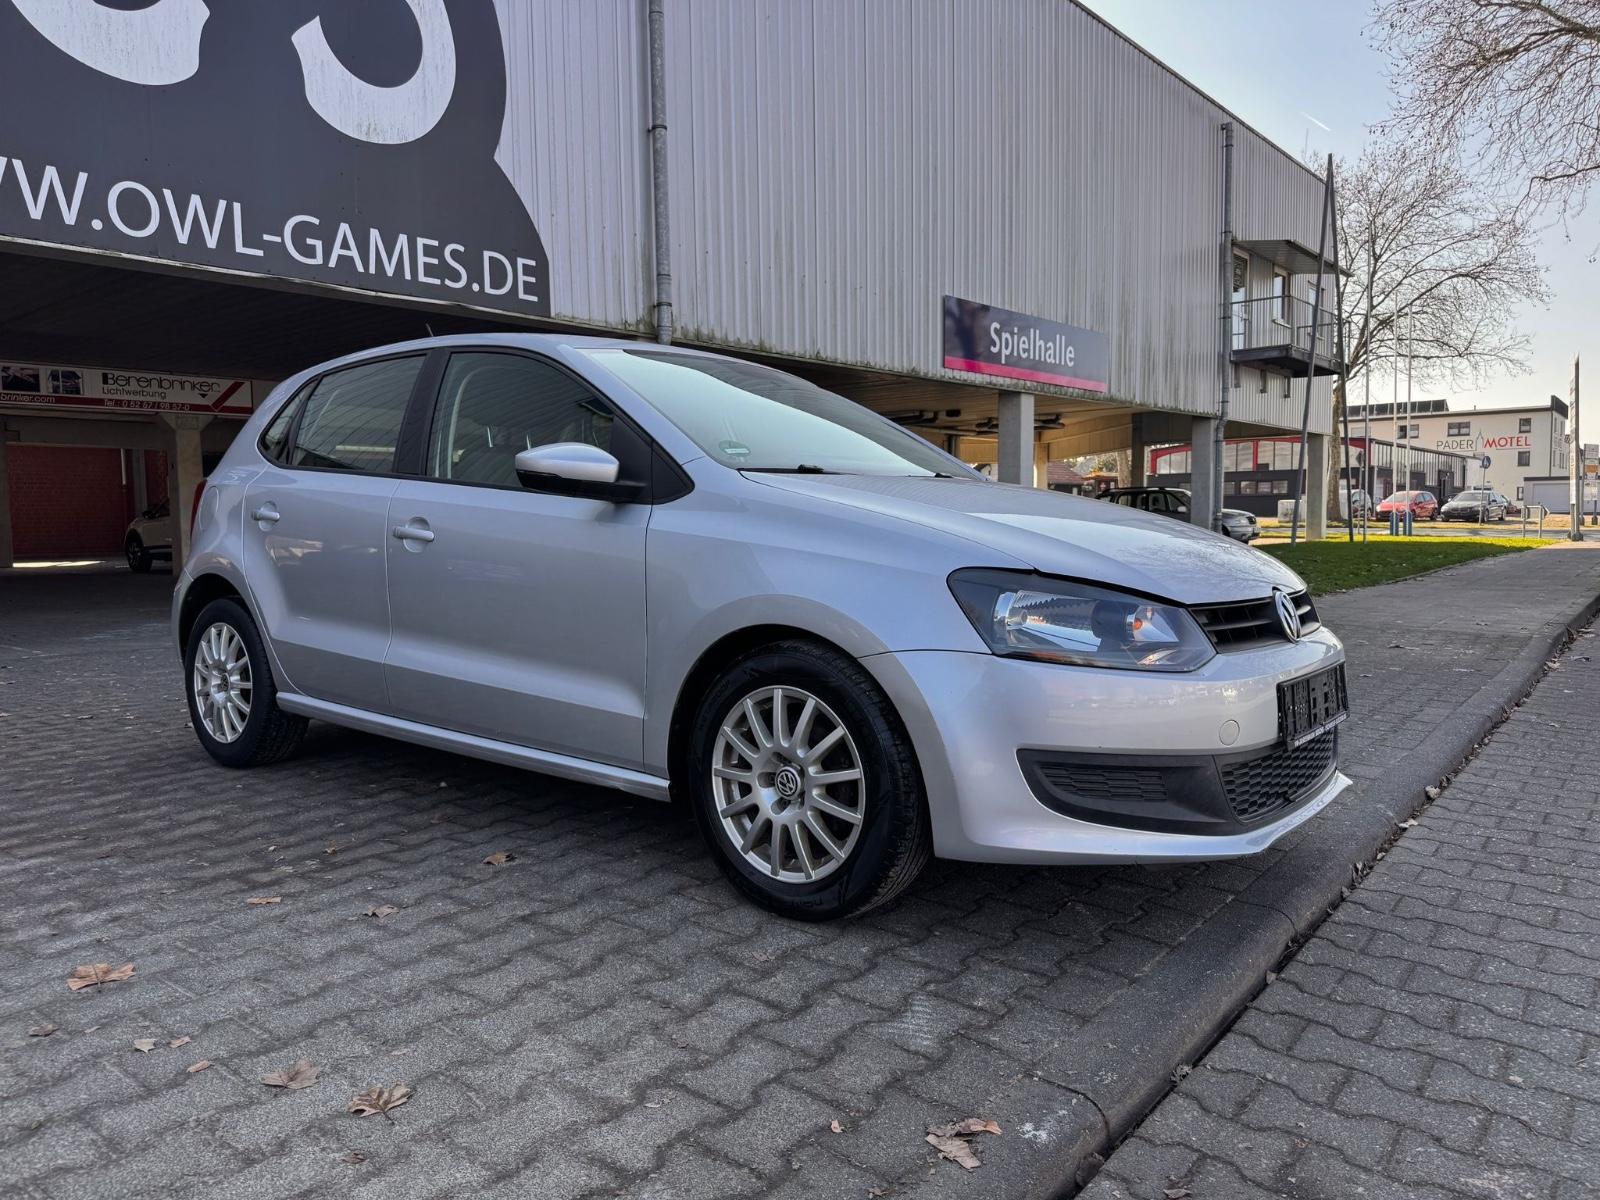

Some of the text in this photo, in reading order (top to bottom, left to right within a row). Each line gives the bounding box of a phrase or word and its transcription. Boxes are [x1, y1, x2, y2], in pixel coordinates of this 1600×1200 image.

[0, 155, 538, 302] W.OWL-GAMES.DE
[990, 321, 1075, 367] Spielhalle
[102, 387, 167, 400] Lichtwerbung
[1436, 436, 1532, 450] PADER MOTEL
